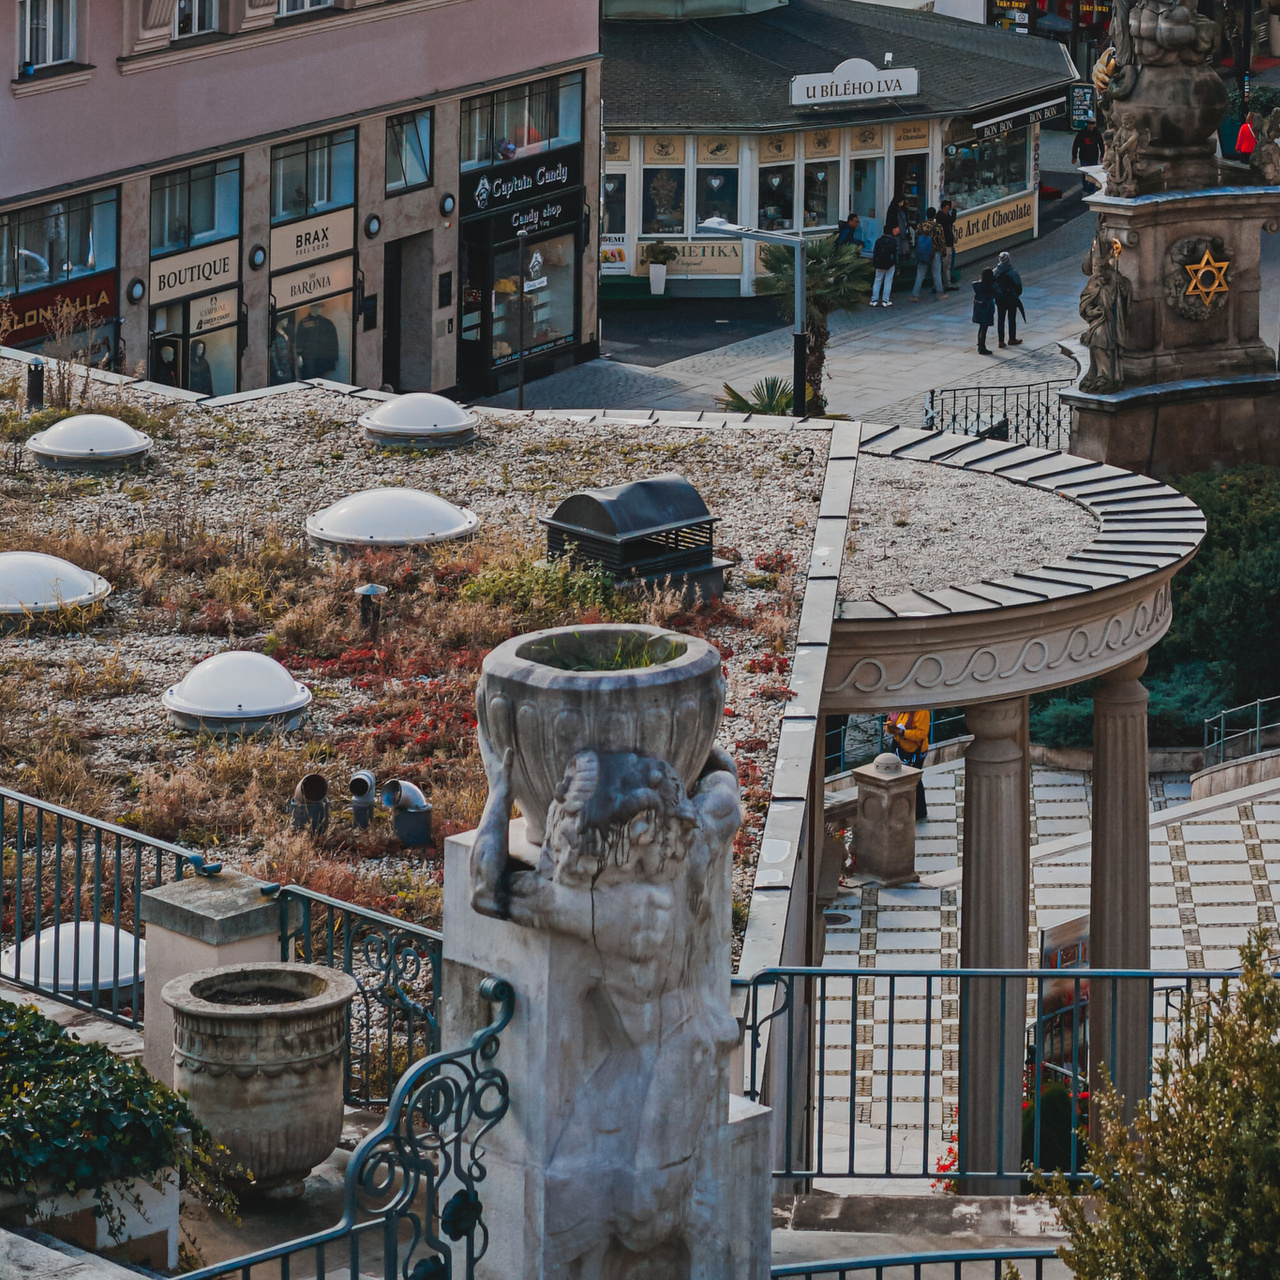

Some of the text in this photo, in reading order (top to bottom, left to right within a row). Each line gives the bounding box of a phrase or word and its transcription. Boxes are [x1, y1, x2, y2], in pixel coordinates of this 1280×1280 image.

[806, 79, 903, 99] U BÍLÉHO LVA
[1029, 106, 1057, 124] BON BON
[984, 124, 997, 138] BON
[1000, 120, 1013, 133] BON
[542, 203, 562, 218] shop
[951, 225, 964, 239] he
[965, 218, 981, 237] Art
[981, 213, 991, 230] of
[992, 202, 1032, 228] Chocolate
[296, 226, 329, 249] BRAX
[157, 256, 230, 291] BOUTIQUE
[290, 275, 331, 297] BARONIA
[63, 290, 110, 313] ALLA
